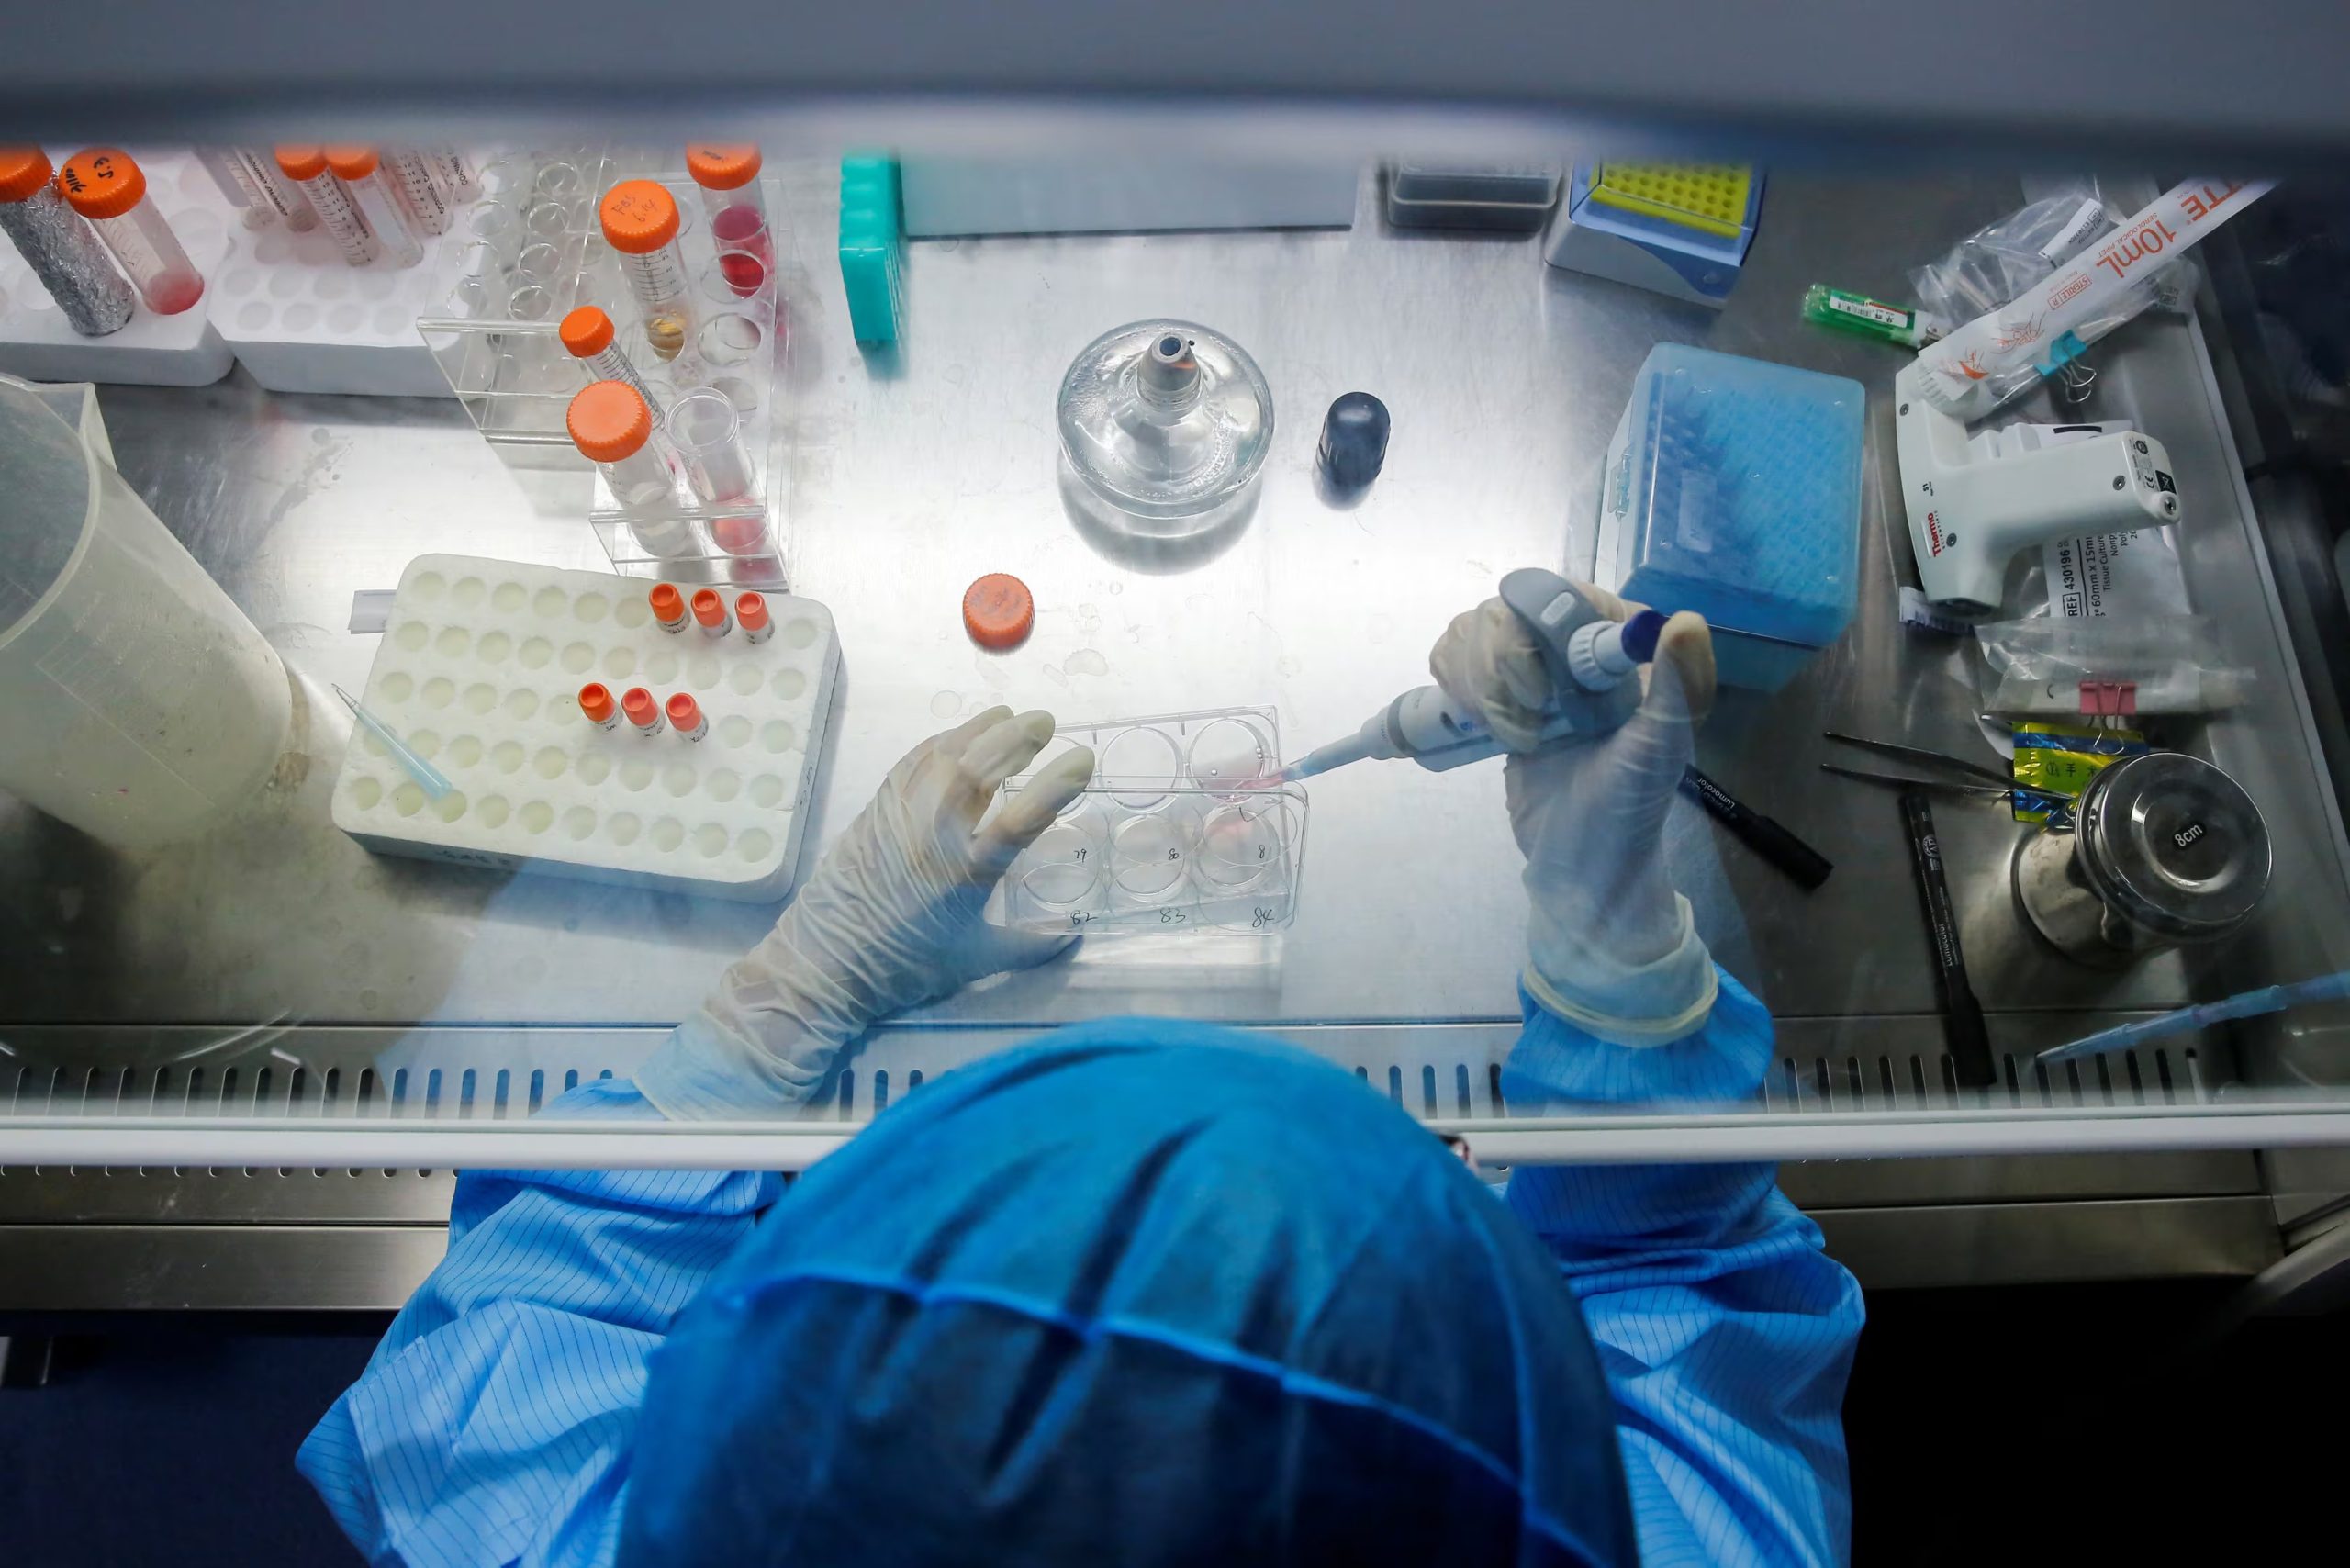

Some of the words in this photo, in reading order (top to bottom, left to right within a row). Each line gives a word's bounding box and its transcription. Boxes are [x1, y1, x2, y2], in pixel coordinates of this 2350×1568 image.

[2116, 212, 2158, 243] SEROLOGICAL
[2095, 219, 2177, 280] 10mL
[2063, 275, 2089, 300] STERILE
[1927, 512, 1942, 557] Thermo
[2060, 549, 2075, 590] 430196
[2102, 566, 2111, 593] Tissue
[2090, 573, 2101, 607] 60mm
[2066, 596, 2078, 617] REF
[1697, 778, 1735, 809] Lumocolor
[2174, 823, 2203, 847] 8cm
[1074, 849, 1087, 863] 79
[1159, 907, 1186, 924] 83
[1252, 907, 1275, 928] 84
